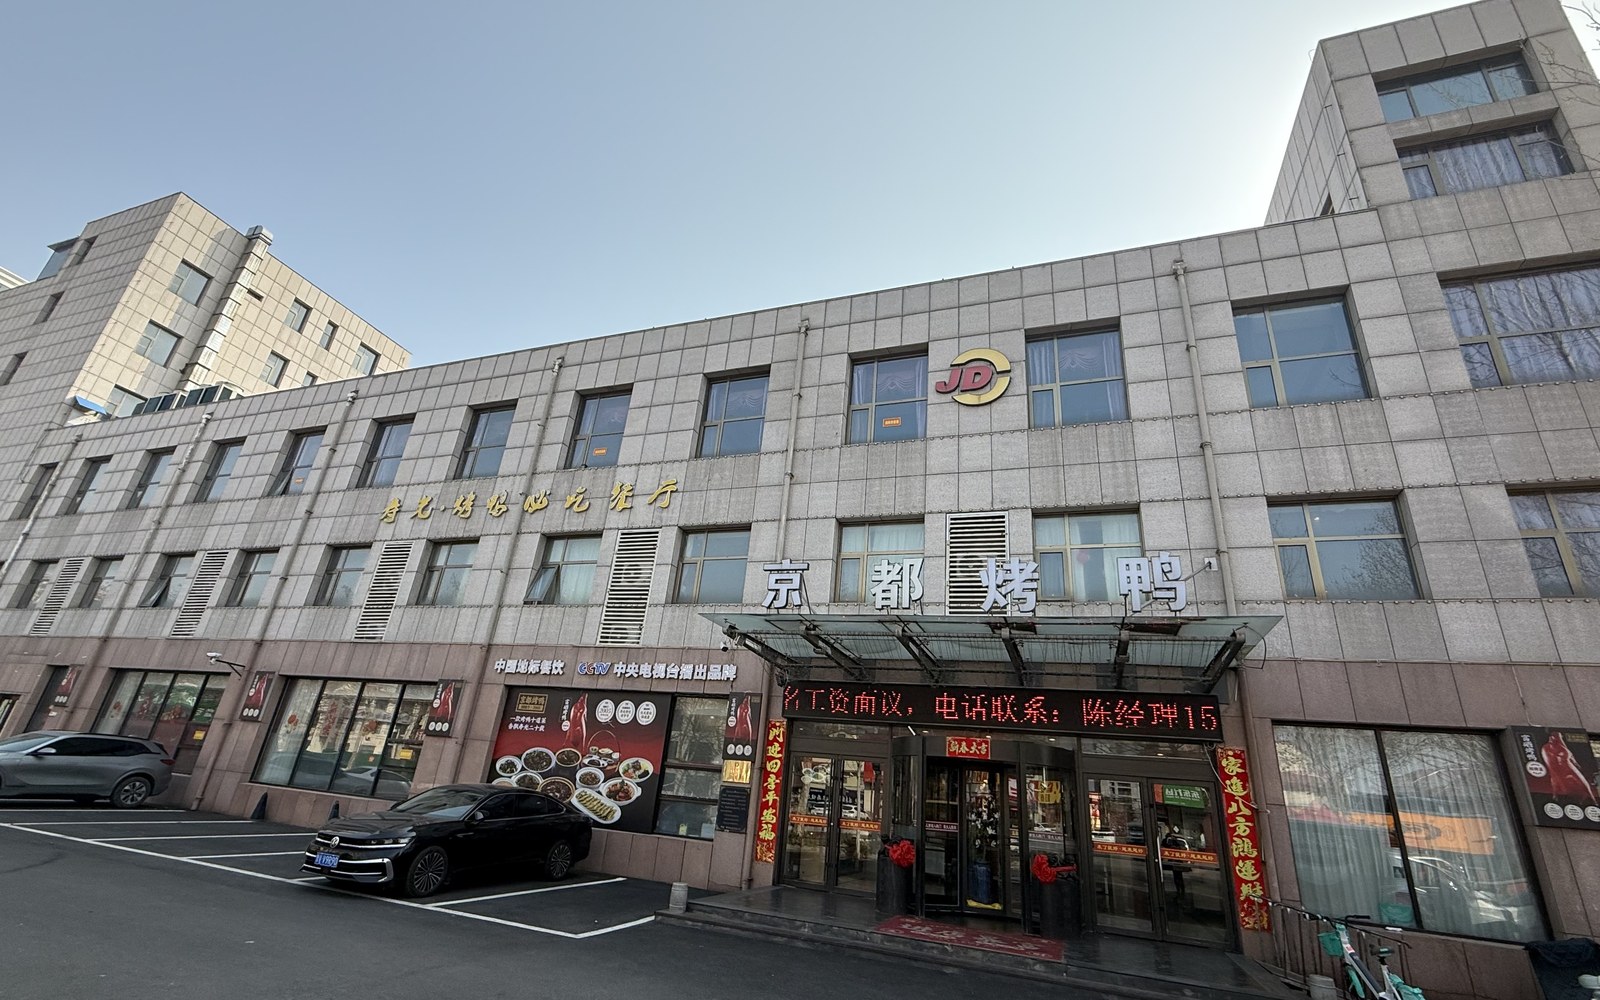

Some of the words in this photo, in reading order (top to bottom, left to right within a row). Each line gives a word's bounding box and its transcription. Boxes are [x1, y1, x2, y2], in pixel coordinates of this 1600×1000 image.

[935, 366, 993, 394] JD
[761, 551, 1188, 612] 京都烤鸭
[494, 658, 566, 675] 中国地标餐饮
[578, 662, 611, 675] CCTV
[613, 661, 737, 681] 中央电视台播出品牌
